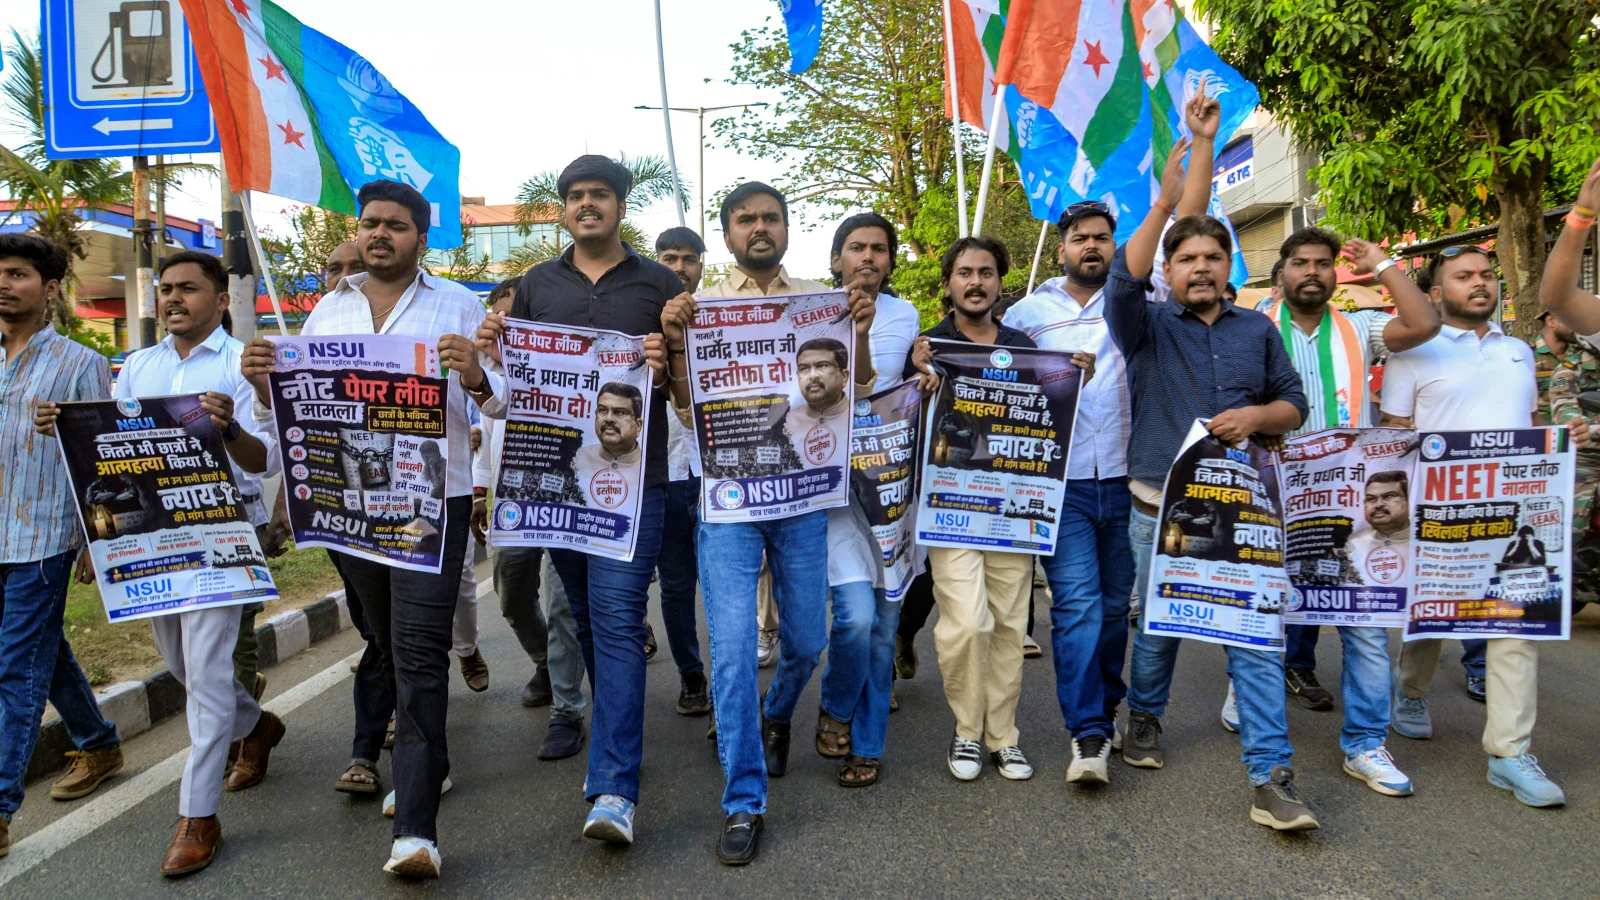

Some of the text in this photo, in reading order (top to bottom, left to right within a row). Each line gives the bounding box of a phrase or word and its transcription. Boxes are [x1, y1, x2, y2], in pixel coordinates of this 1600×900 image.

[694, 306, 774, 326] नीट पेपर लीक
[793, 305, 840, 326] LEAKED
[505, 328, 582, 352] नीट पेपर लीक
[694, 330, 714, 340] मामले
[309, 342, 364, 358] NSUI
[736, 338, 775, 357] प्रधान
[778, 333, 796, 354] जी
[311, 358, 330, 366] नेशनल
[600, 351, 640, 364] LEAKED
[540, 369, 579, 390] प्रधान
[582, 370, 600, 392] जी
[698, 358, 792, 392] इस्तीफा दो!
[982, 368, 1018, 382] NSUI
[279, 372, 440, 406] नीट पेपर लीक
[955, 384, 1048, 410] जितने भी छात्रों ने
[300, 404, 358, 420] मामला
[568, 394, 592, 418] दो!
[954, 397, 1054, 426] आत्महत्या किया है,
[378, 409, 430, 420] छात्रों के भविष्य
[116, 417, 156, 431] NSUI
[372, 420, 440, 430] के साथ धोखा बंद करो!
[991, 424, 1002, 432] हम
[1014, 426, 1030, 436] सभी
[1030, 428, 1047, 438] छात्रों
[1048, 430, 1056, 438] के
[350, 432, 374, 440] NEET
[864, 437, 878, 450] भी
[880, 430, 908, 448] छात्रों
[1324, 436, 1346, 452] लीक
[1470, 432, 1514, 448] NSUI
[97, 437, 202, 459] जितने भी छात्रों ने
[397, 440, 418, 450] परीक्षा
[809, 440, 830, 454] इस्तीफा
[987, 435, 1036, 460] न्याय
[1364, 440, 1409, 456] LEAKED
[96, 450, 219, 476] आत्महत्या किया है,
[816, 452, 825, 460] दो!
[396, 460, 422, 472] धांधली
[992, 458, 1004, 468] की
[1004, 459, 1018, 470] मांग
[1019, 460, 1036, 471] करते
[1502, 460, 1560, 479] पेपर लीक
[157, 470, 228, 486] हम उन सभी छात्रों के
[400, 472, 416, 480] चाहिए
[798, 474, 811, 486] राष्ट्रीय
[812, 474, 820, 482] छात्र
[878, 472, 889, 482] हम
[1194, 468, 1233, 486] जितने
[1312, 466, 1346, 485] प्रधान
[1350, 463, 1366, 482] जी
[1424, 462, 1500, 502] NEET
[395, 480, 430, 494] हमें न्याय!
[596, 485, 622, 496] इस्तीफा
[747, 478, 793, 504] NSUI
[1184, 484, 1250, 504] आत्महत्या
[1502, 480, 1547, 496] मामला
[157, 482, 218, 510] न्याय
[604, 496, 614, 504] दो!
[1337, 484, 1360, 508] दो!
[173, 506, 236, 522] की मांग करते हैं!
[379, 502, 391, 512] नहीं
[392, 504, 412, 512] चलेगी!
[750, 509, 762, 517] छात्र
[788, 504, 798, 512] राष्ट्र
[1423, 504, 1516, 520] छात्रों के भविष्य के साथ
[1526, 502, 1550, 511] NEET
[312, 510, 367, 538] NSUI
[525, 506, 571, 528] NSUI
[578, 512, 616, 526] राष्ट्रीय छात्र संघ
[935, 512, 970, 528] NSUI
[1532, 513, 1556, 526] LEAK
[523, 532, 535, 540] छात्र
[536, 532, 552, 540] एकता
[562, 534, 574, 542] राष्ट्र
[1422, 518, 1514, 541] खिलवाड़ बंद करो!
[125, 578, 172, 598] NSUI
[1306, 590, 1350, 610] NSUI
[1168, 602, 1214, 620] NSUI
[1414, 602, 1455, 618] NSUI
